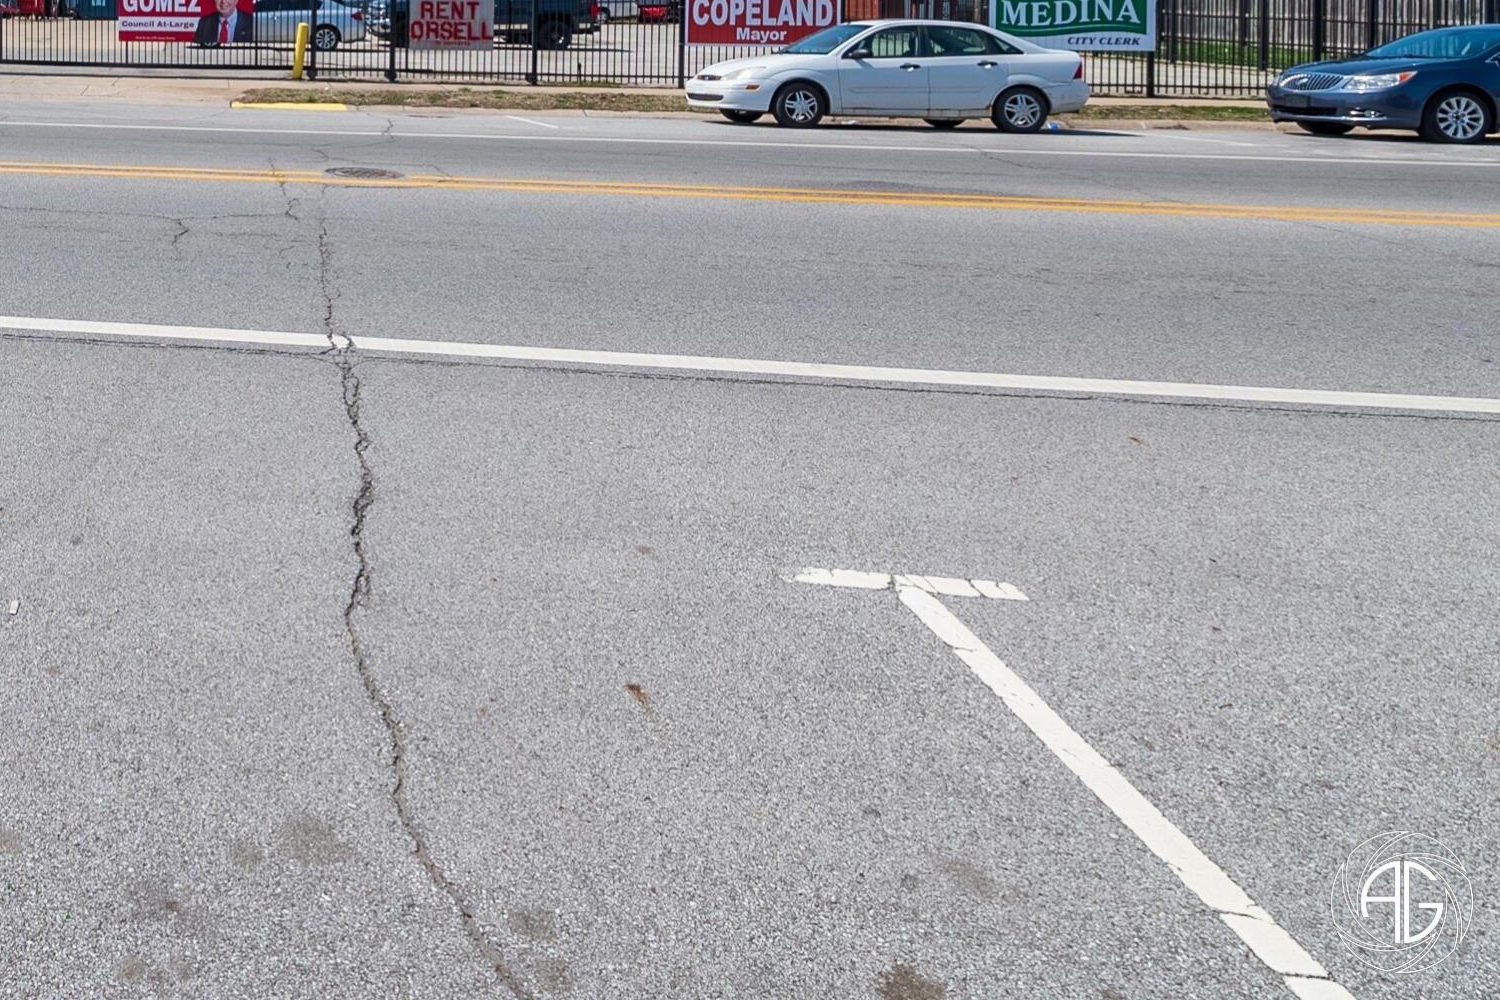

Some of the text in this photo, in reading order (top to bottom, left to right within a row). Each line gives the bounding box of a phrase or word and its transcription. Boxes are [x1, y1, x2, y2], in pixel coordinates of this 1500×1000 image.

[420, 1, 480, 20] RENT
[121, 20, 195, 29] Council At-Large
[736, 27, 788, 43] Mayor
[1067, 36, 1141, 46] CITY CLERK
